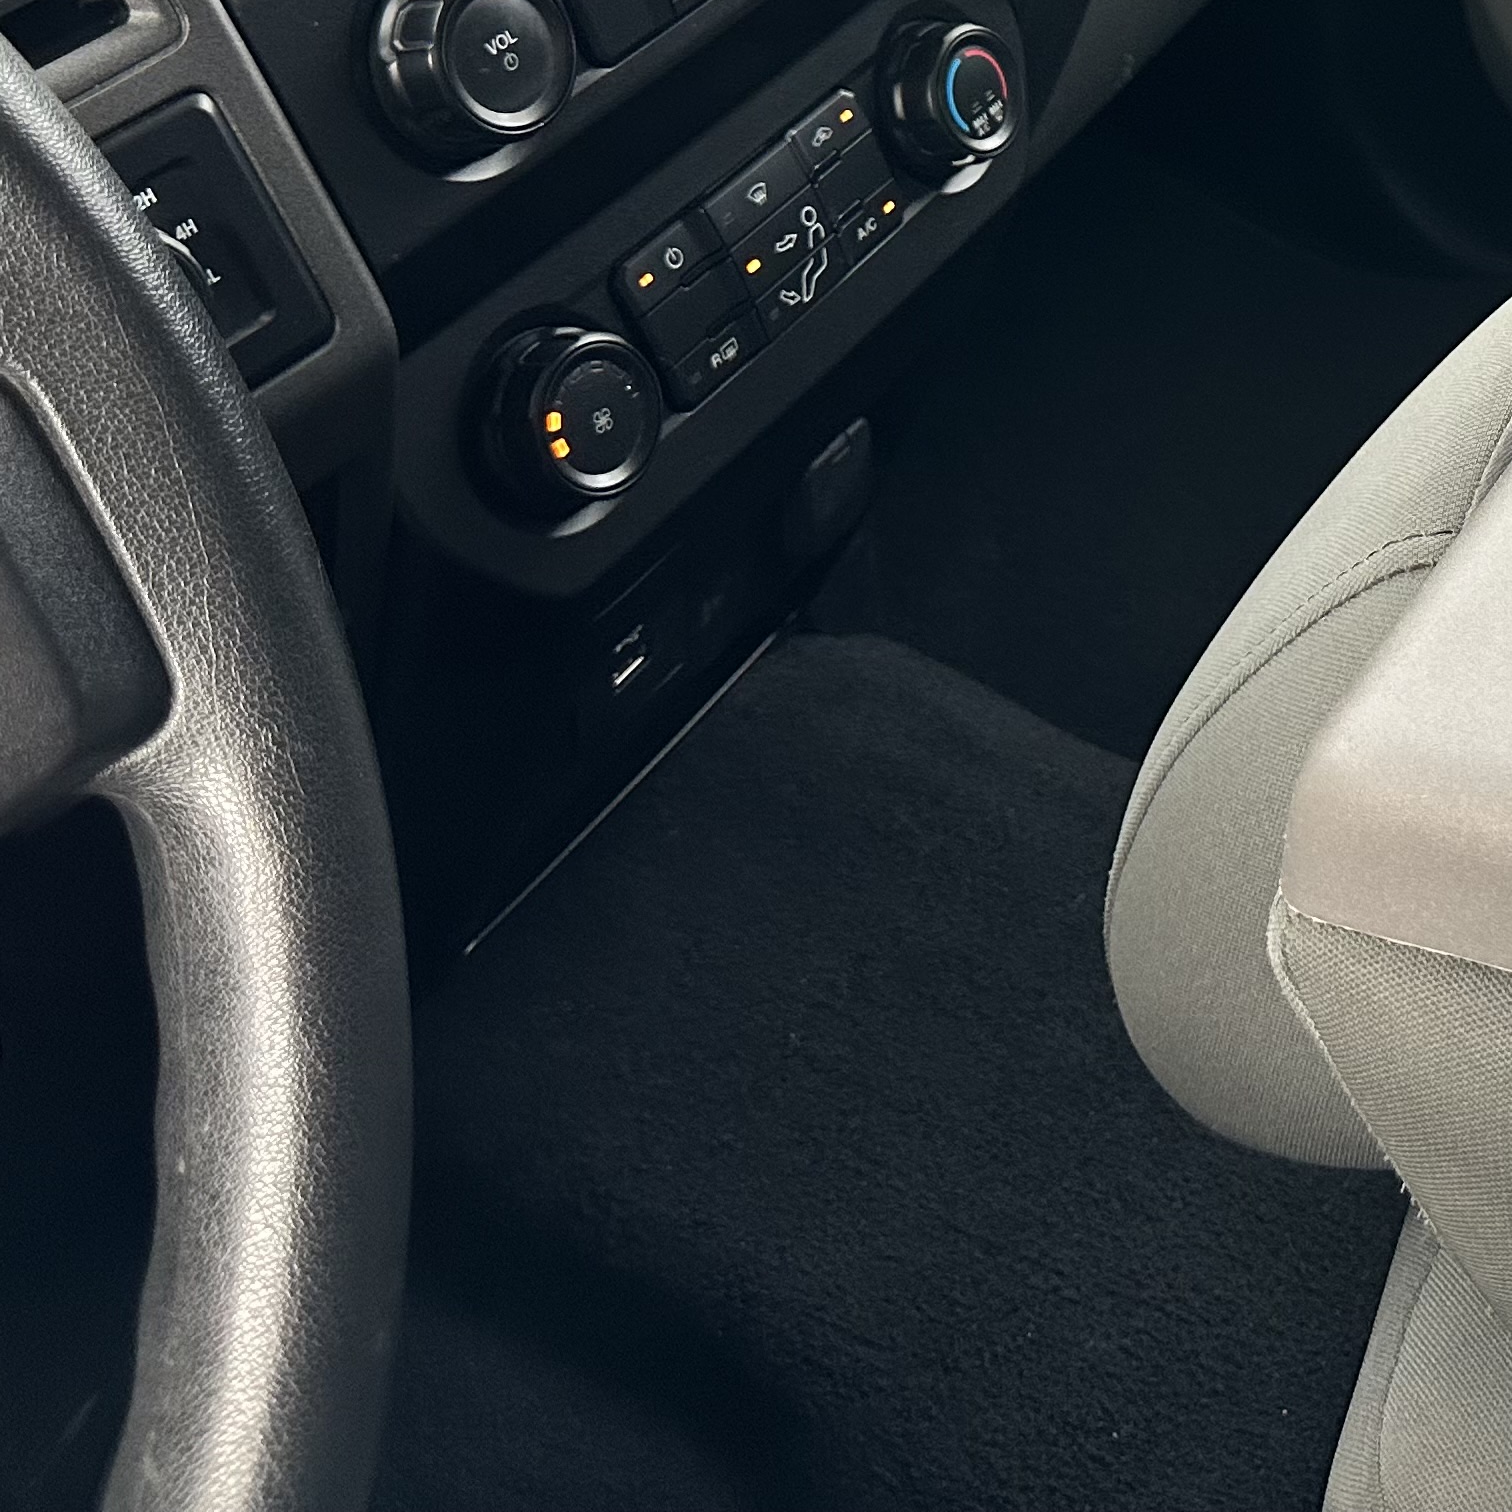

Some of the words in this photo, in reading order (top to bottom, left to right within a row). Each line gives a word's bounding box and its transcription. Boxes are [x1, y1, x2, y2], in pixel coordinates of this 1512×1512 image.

[483, 30, 519, 55] VOL
[133, 187, 158, 211] 2H
[175, 218, 198, 240] 4H
[857, 216, 877, 240] A/C
[206, 268, 221, 286] L
